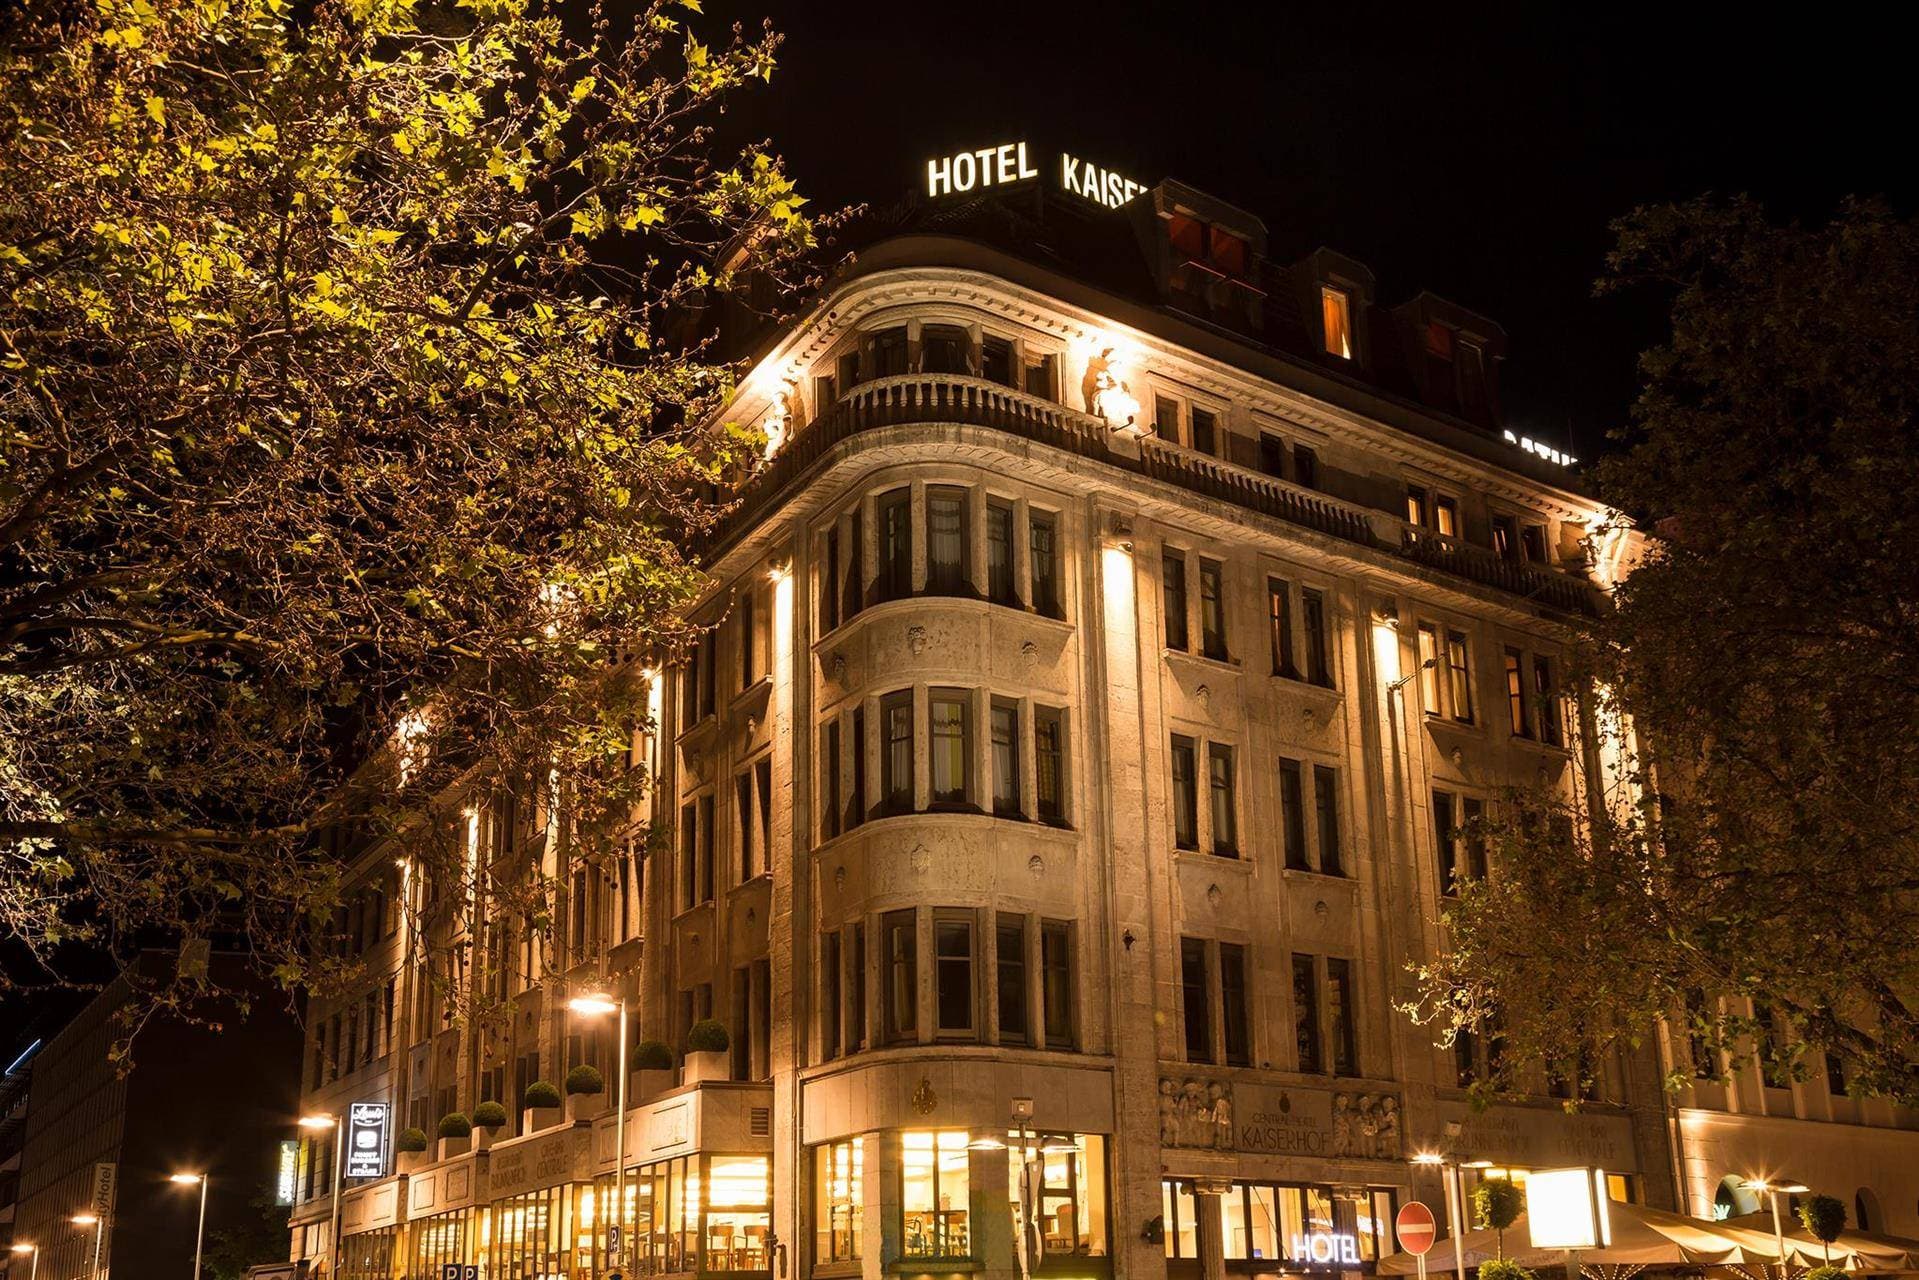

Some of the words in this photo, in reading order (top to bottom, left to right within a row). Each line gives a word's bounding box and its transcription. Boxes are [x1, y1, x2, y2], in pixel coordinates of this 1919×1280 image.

[928, 141, 1038, 198] HOTEL
[1062, 152, 1149, 210] KAISE
[1241, 1125, 1330, 1153] KAISERHOF
[1292, 1233, 1361, 1264] HOTEL
[446, 1267, 458, 1280] P
